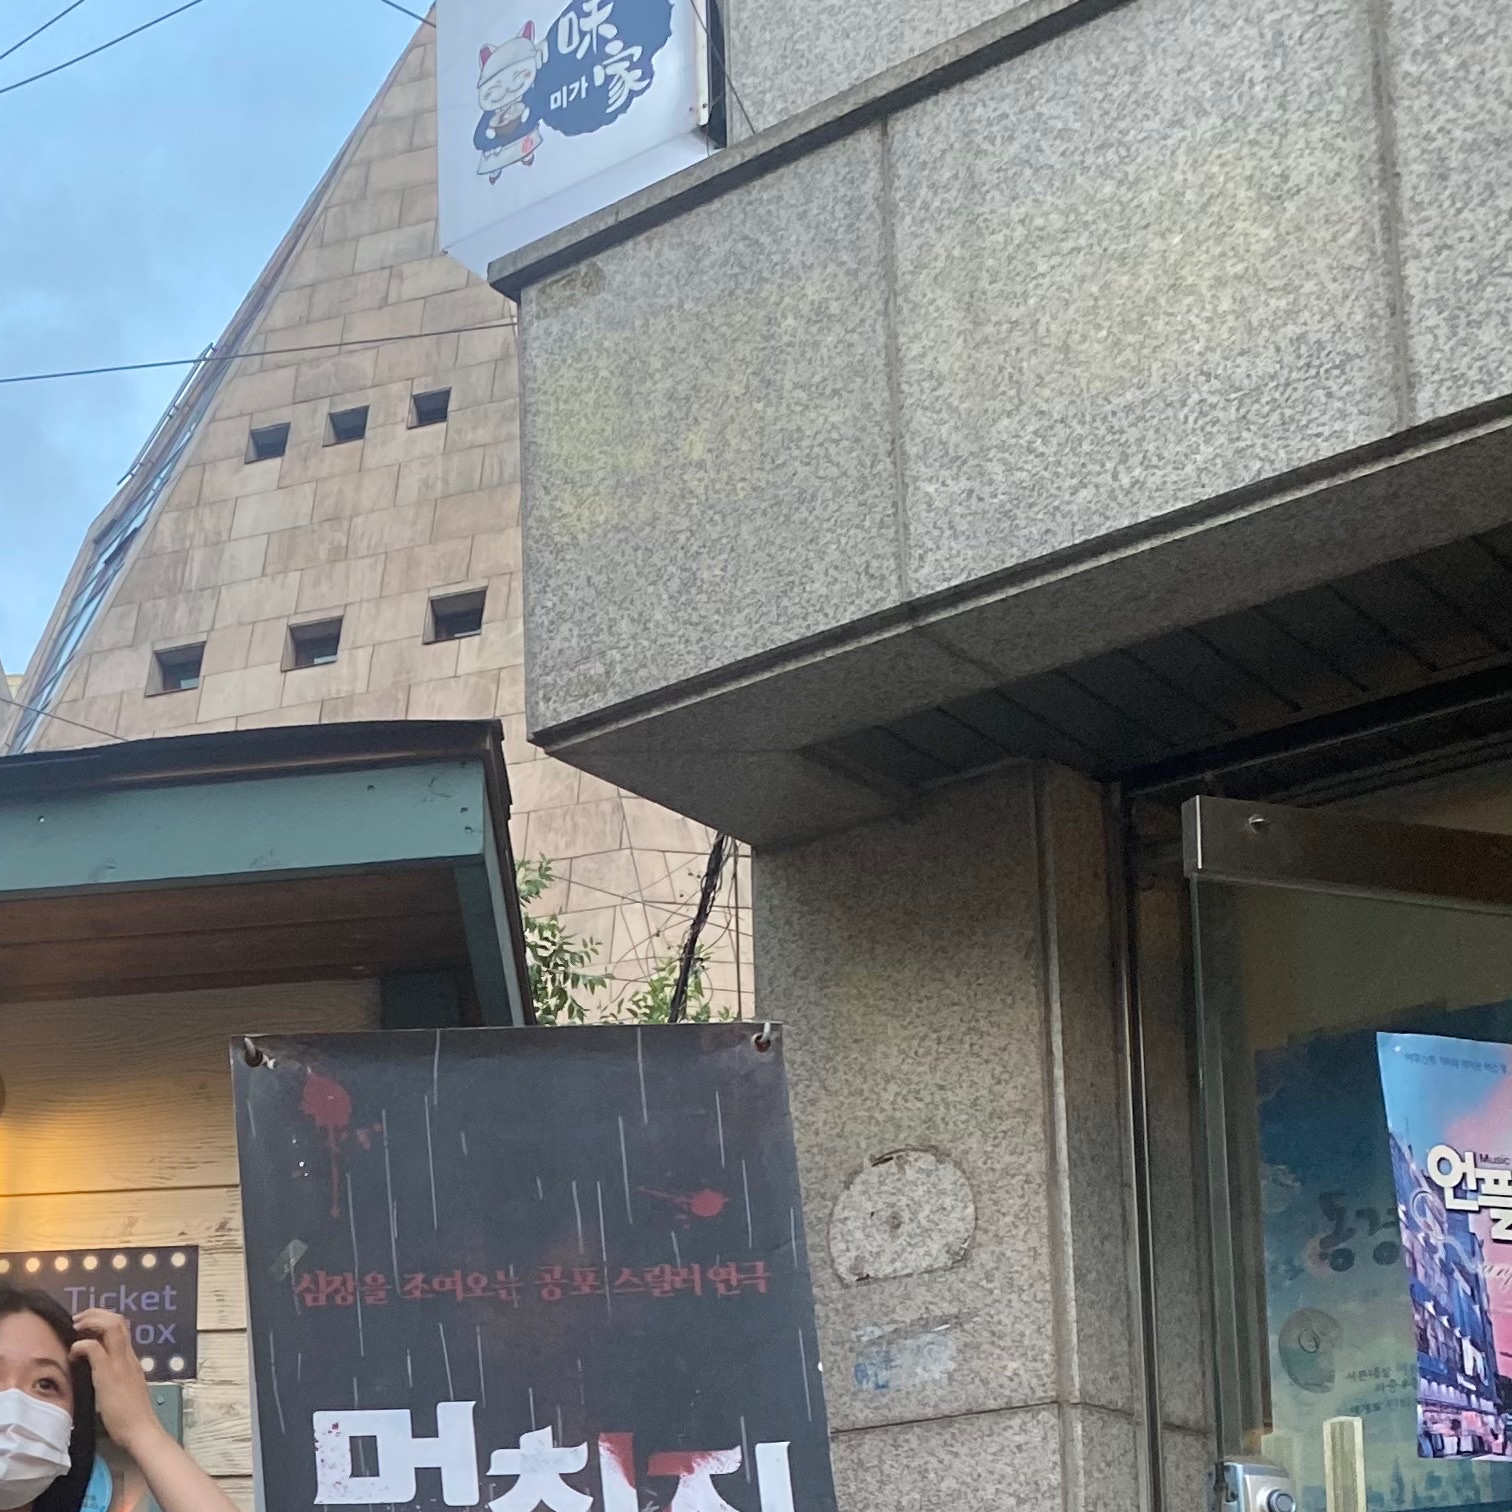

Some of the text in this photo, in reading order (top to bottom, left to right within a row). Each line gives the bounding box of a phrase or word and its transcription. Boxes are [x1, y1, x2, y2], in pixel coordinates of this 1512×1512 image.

[550, 82, 589, 111] 미가
[295, 1270, 391, 1307] 심장을
[535, 1265, 604, 1301] 공포
[613, 1263, 702, 1297] 스릴러
[707, 1261, 769, 1298] 연극
[64, 1285, 177, 1316] Ticket
[126, 1320, 176, 1344] ox
